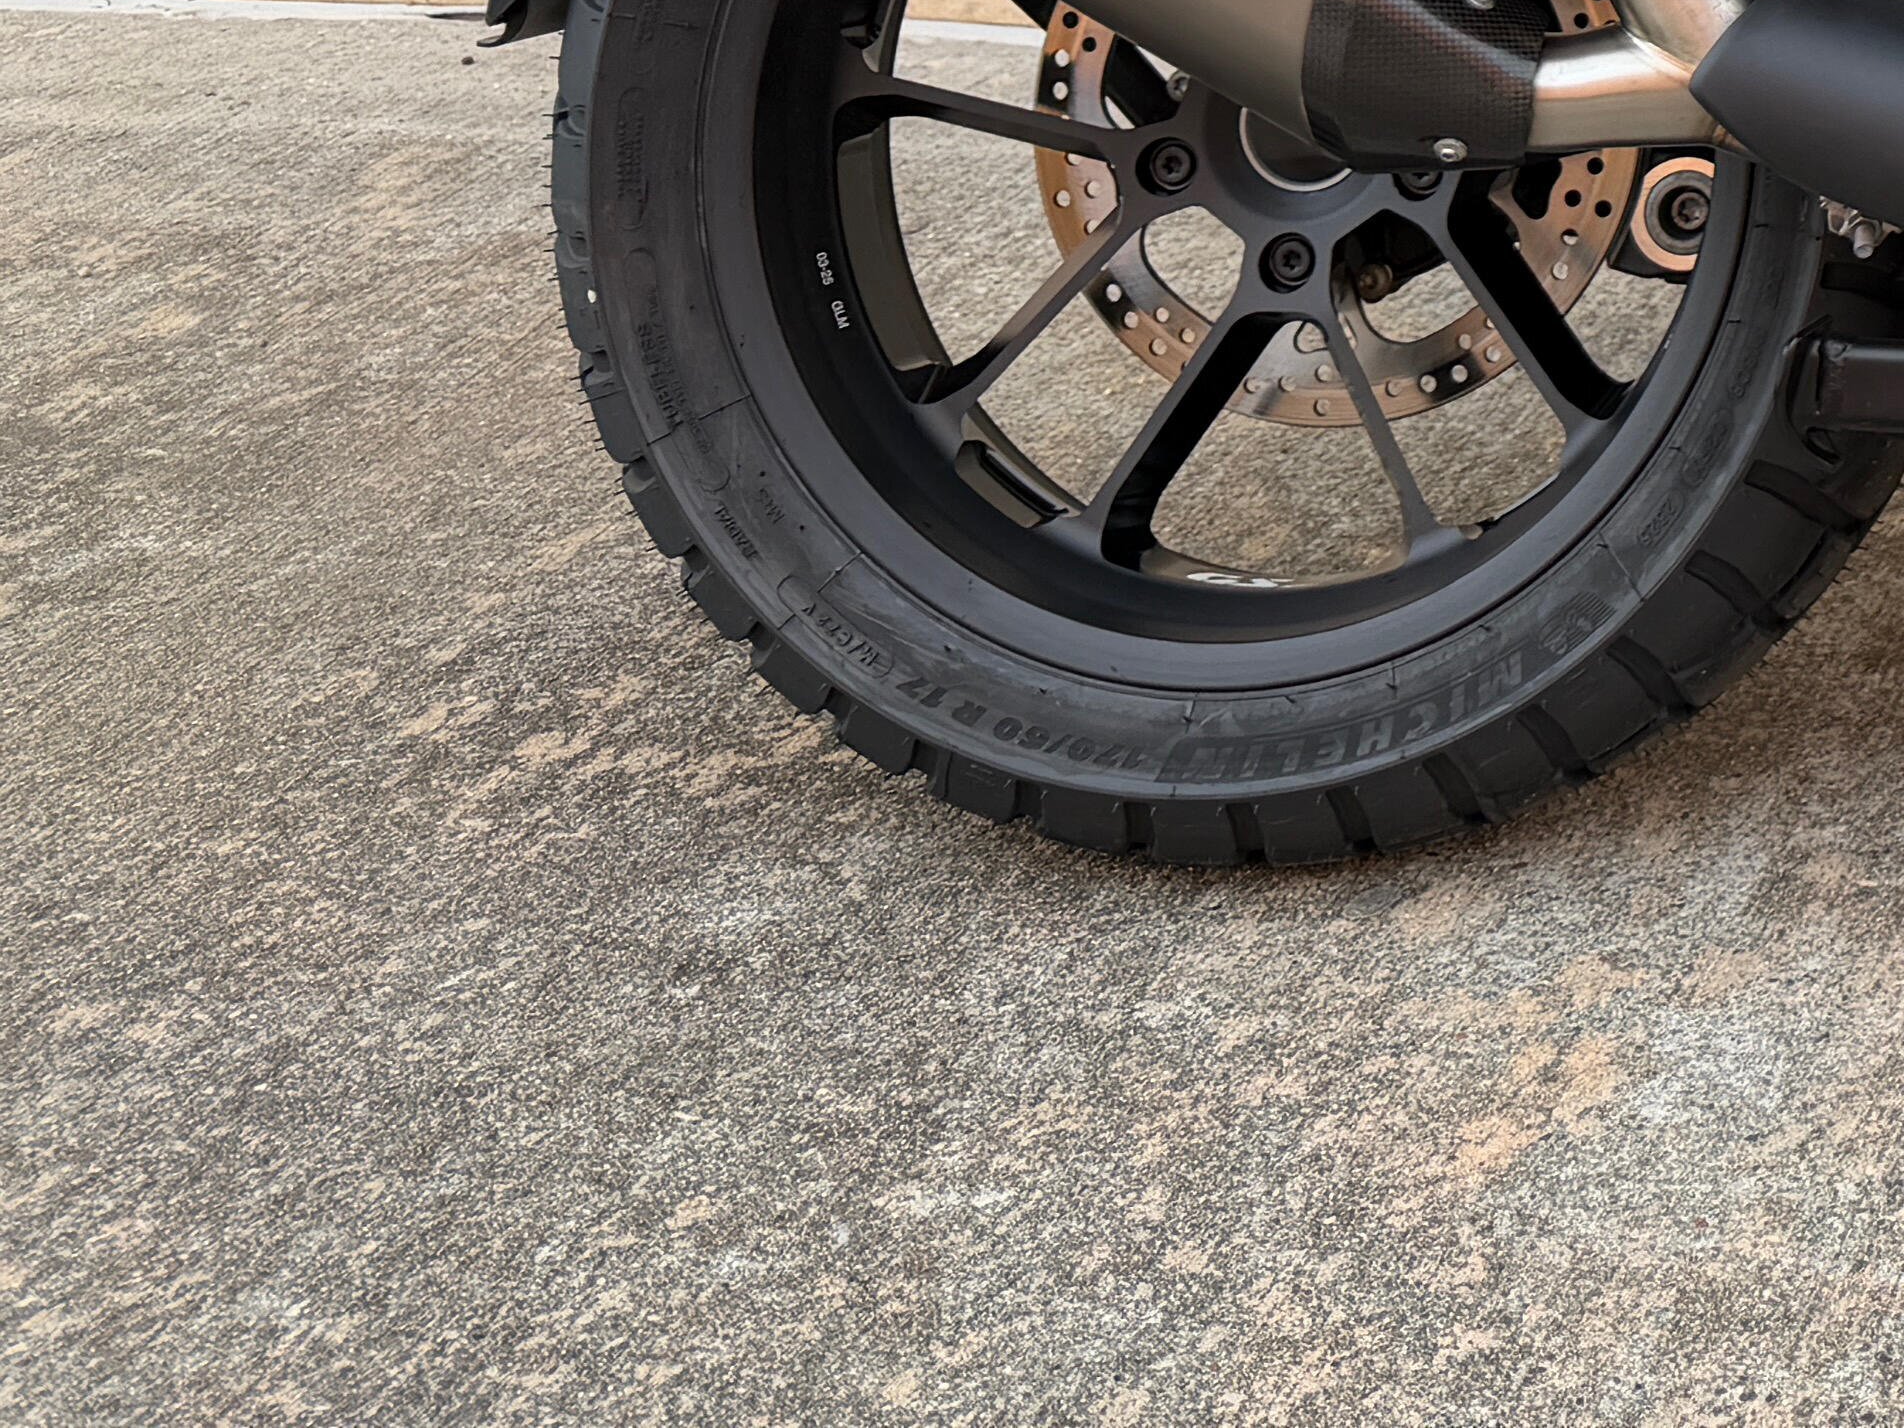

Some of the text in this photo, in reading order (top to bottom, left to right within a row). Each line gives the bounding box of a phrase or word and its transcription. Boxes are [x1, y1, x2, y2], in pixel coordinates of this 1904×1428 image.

[894, 668, 947, 710] 17
[949, 695, 987, 730] R
[1181, 653, 1526, 776] MICHELIN
[992, 715, 1146, 771] 170/60
